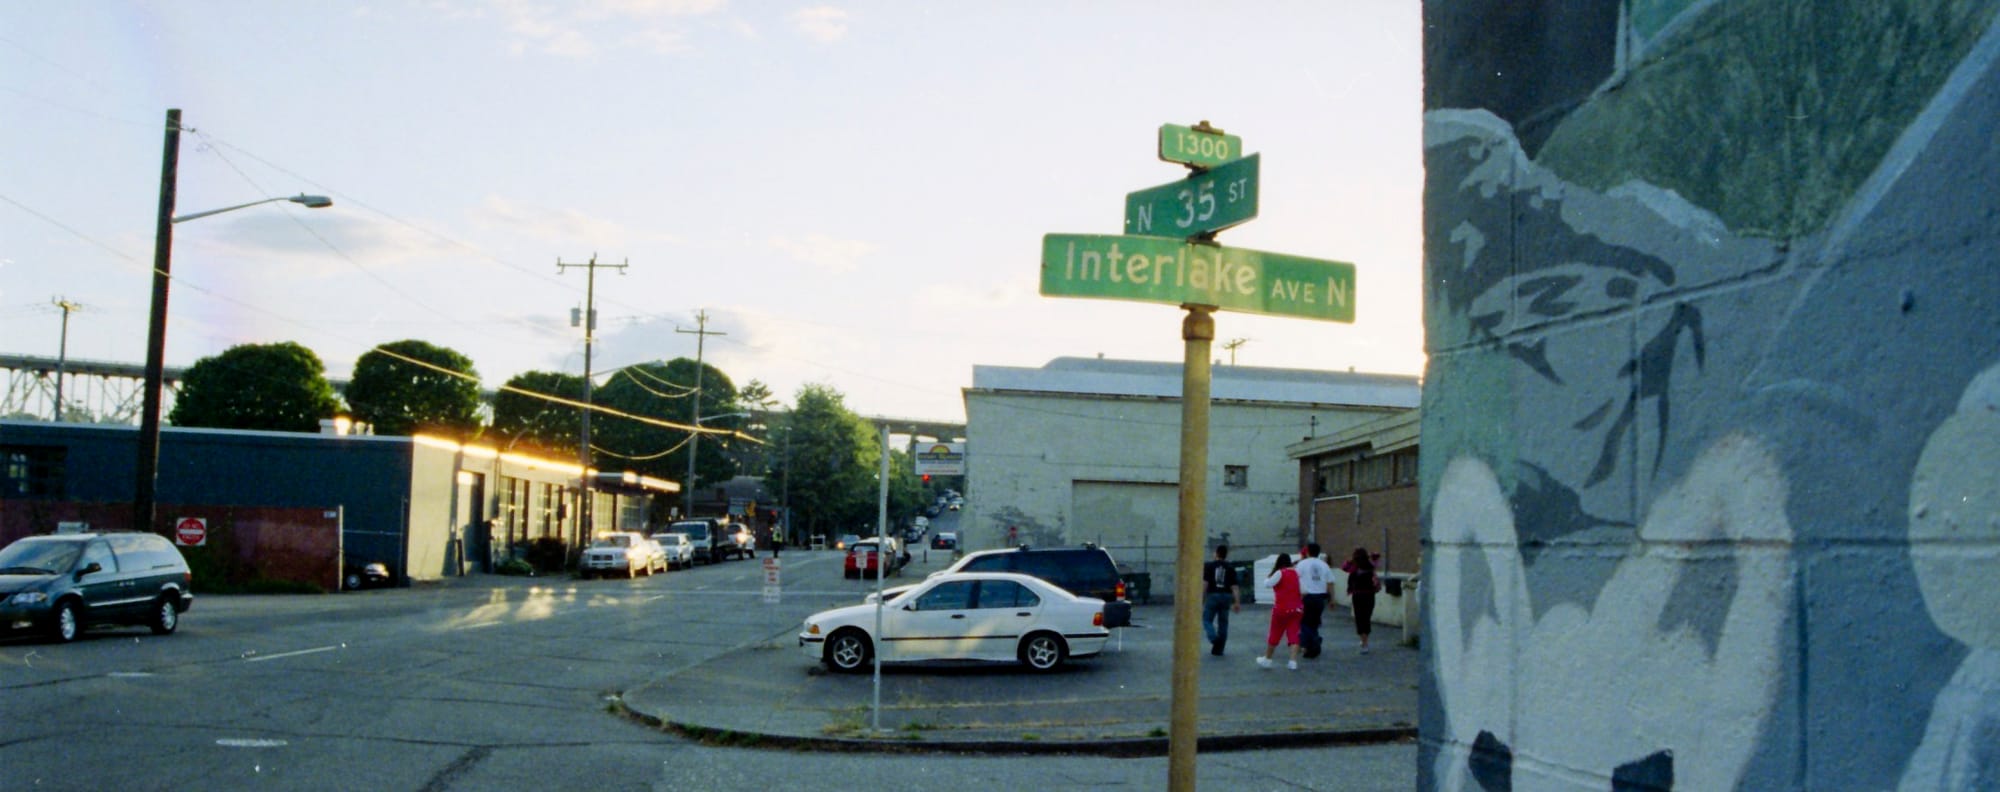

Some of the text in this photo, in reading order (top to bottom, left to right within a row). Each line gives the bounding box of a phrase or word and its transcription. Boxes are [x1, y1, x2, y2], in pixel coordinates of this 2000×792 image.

[1177, 134, 1228, 160] 1300
[1138, 179, 1247, 232] N 35 ST
[1065, 241, 1346, 307] Interlake AVE N
